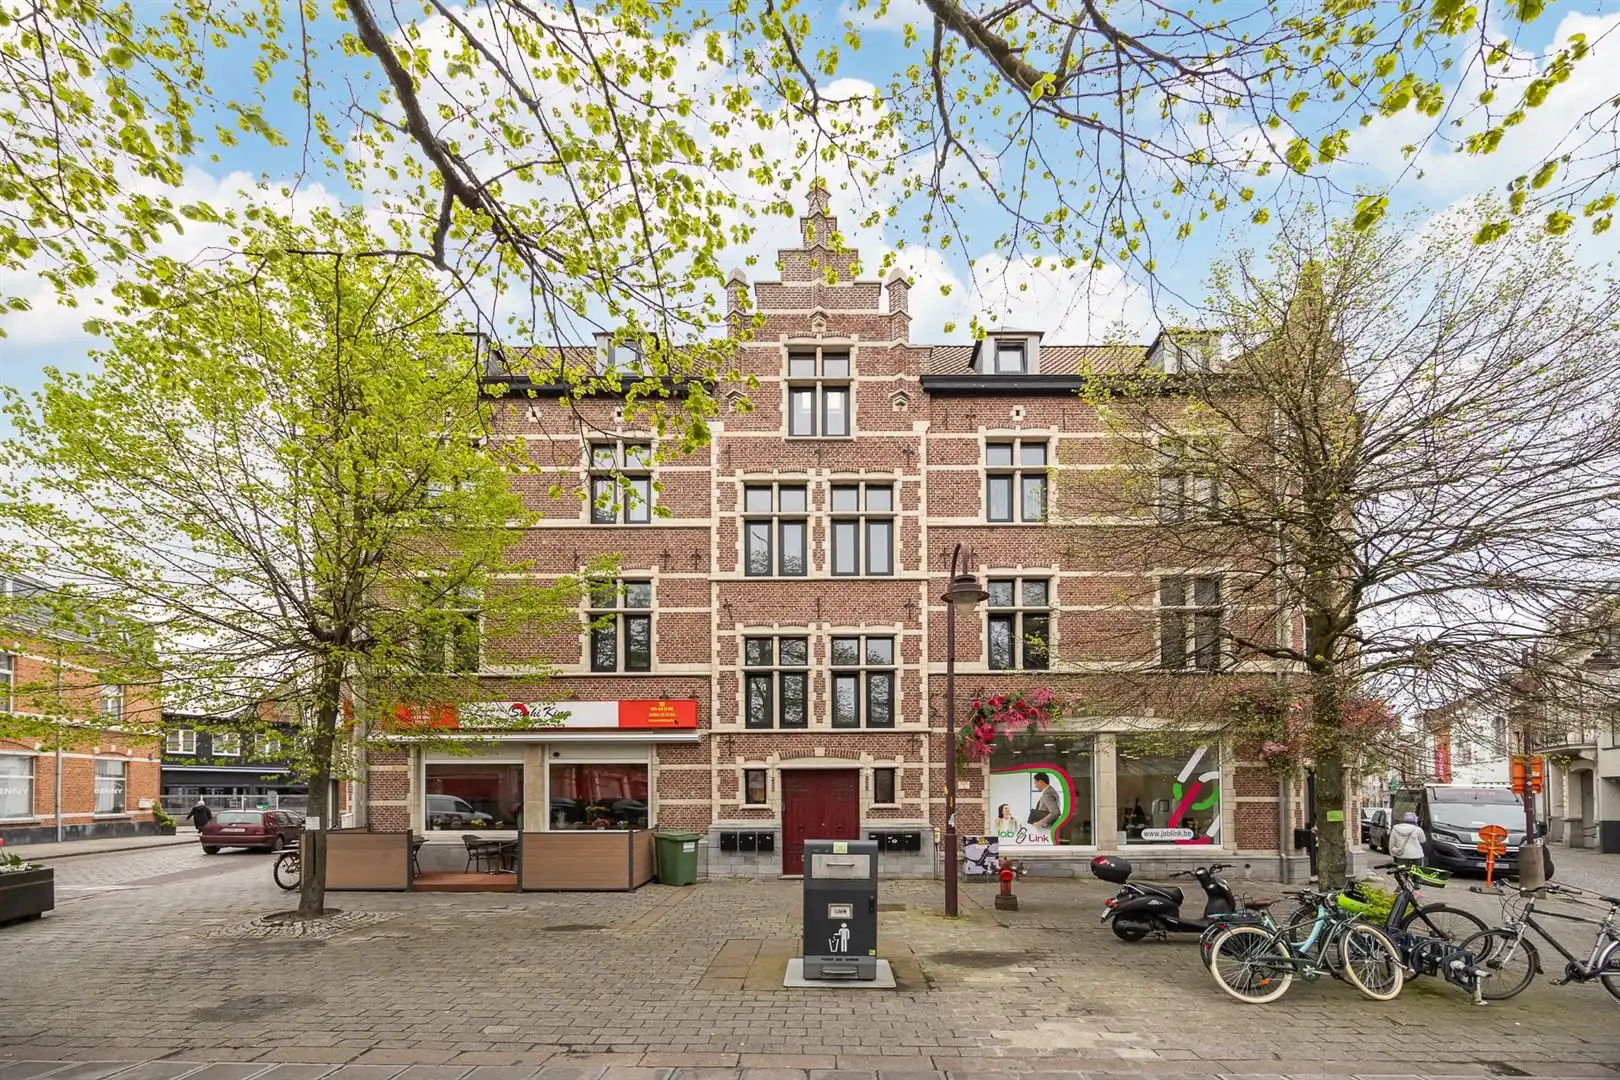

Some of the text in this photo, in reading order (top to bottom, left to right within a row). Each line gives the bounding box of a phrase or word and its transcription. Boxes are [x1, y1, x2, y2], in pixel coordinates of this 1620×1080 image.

[508, 704, 571, 720] Shi Kin
[0, 787, 29, 795] ENNY
[997, 829, 1049, 843] Job Link
[1143, 830, 1192, 839] www.joblink.be
